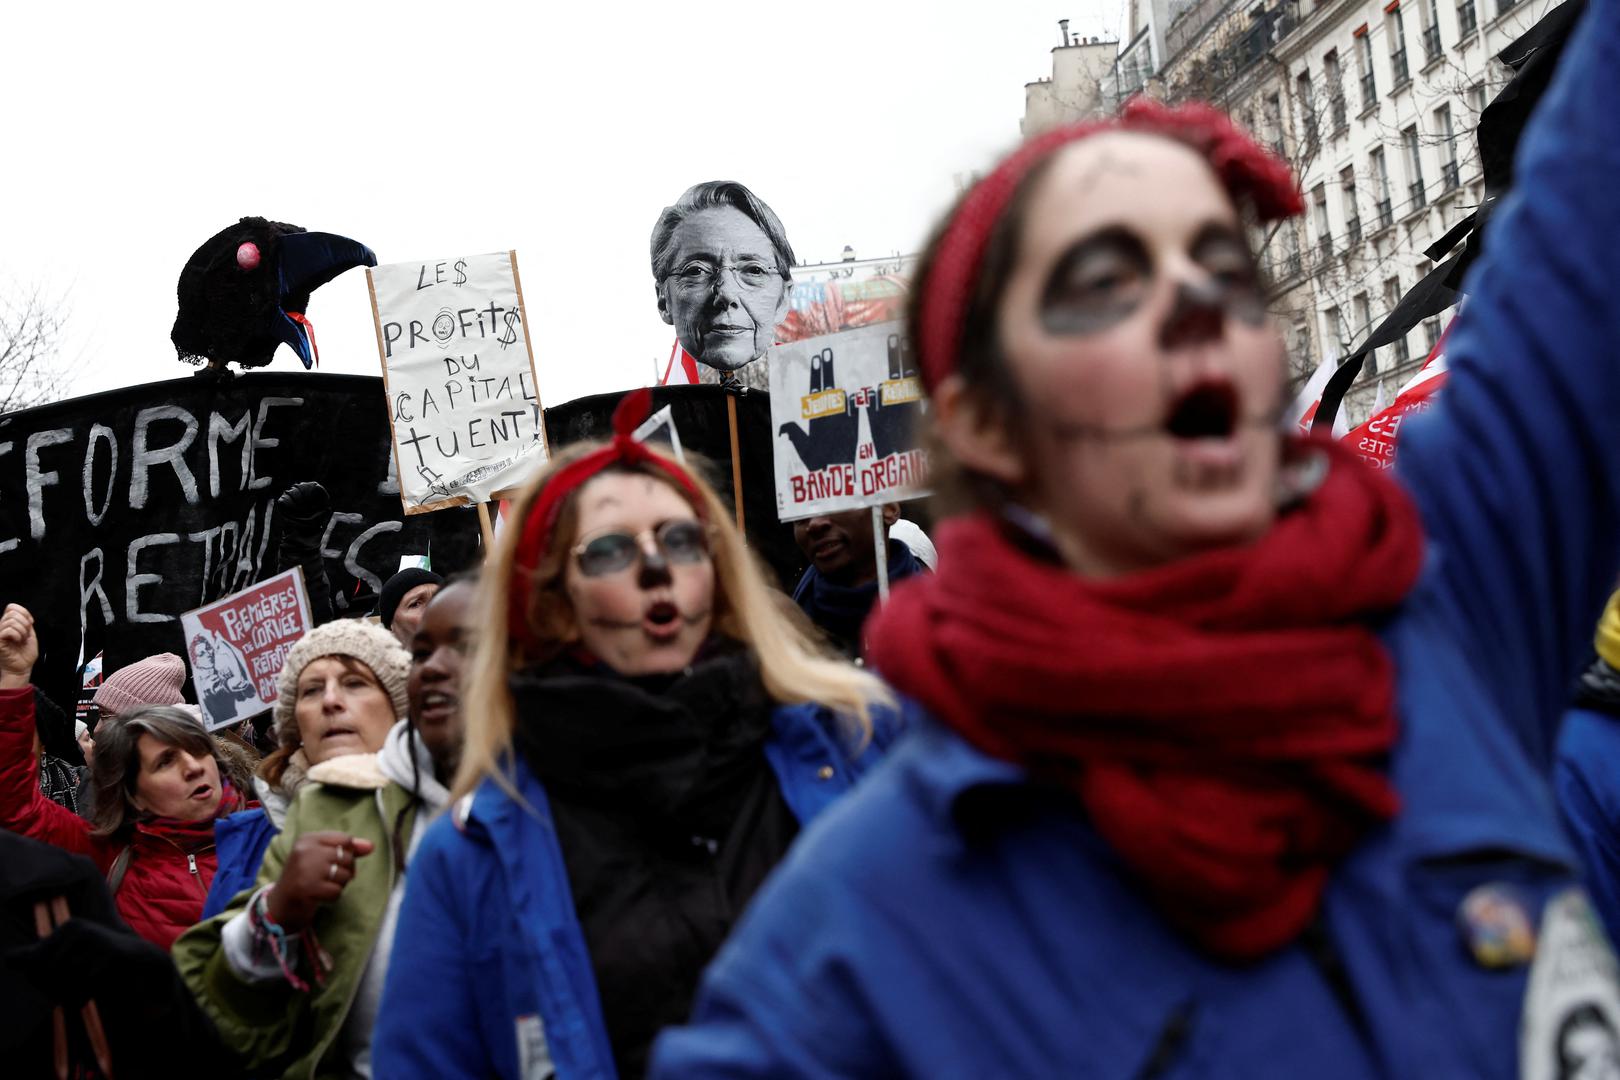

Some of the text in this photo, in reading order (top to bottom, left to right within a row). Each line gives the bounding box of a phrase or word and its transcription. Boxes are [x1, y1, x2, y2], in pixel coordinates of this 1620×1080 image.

[444, 354, 480, 376] DU
[856, 386, 872, 405] ET
[859, 443, 873, 459] EN
[0, 397, 304, 553] FORME
[790, 466, 854, 502] BANDE
[251, 611, 301, 649] CORVÉE
